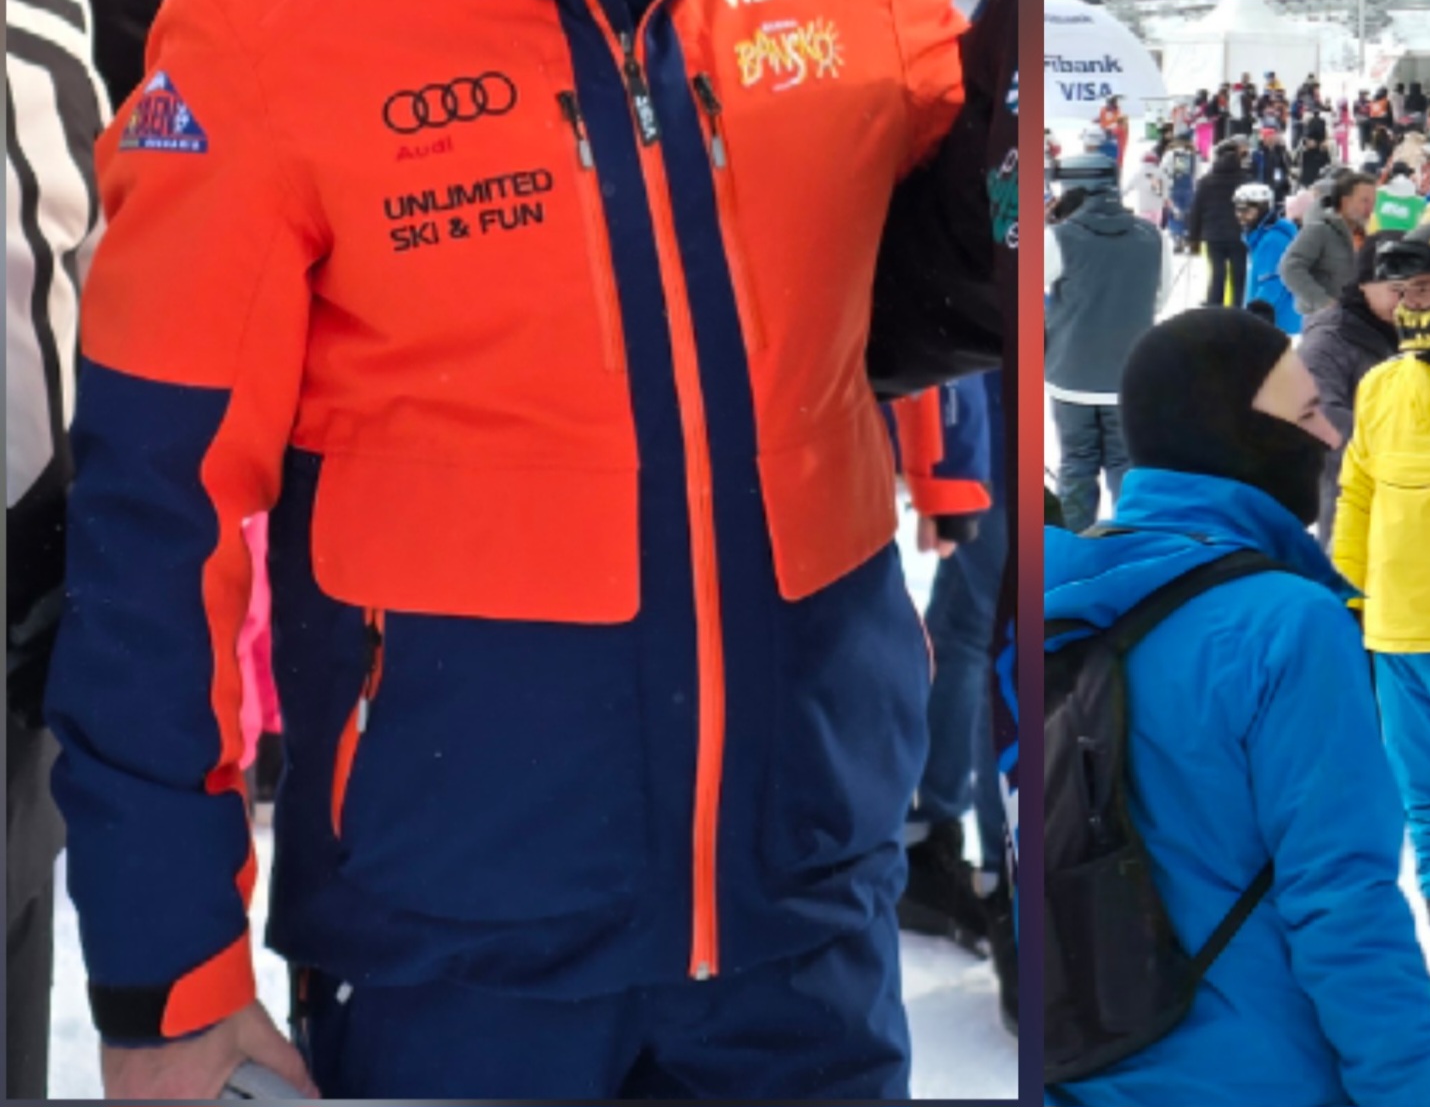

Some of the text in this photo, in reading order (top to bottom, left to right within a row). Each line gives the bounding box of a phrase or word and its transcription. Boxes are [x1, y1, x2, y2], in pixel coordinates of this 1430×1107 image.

[1056, 80, 1113, 101] VISA
[395, 136, 453, 162] Audi
[383, 168, 554, 221] UNLIMITED
[389, 201, 544, 253] SKI & FUN
